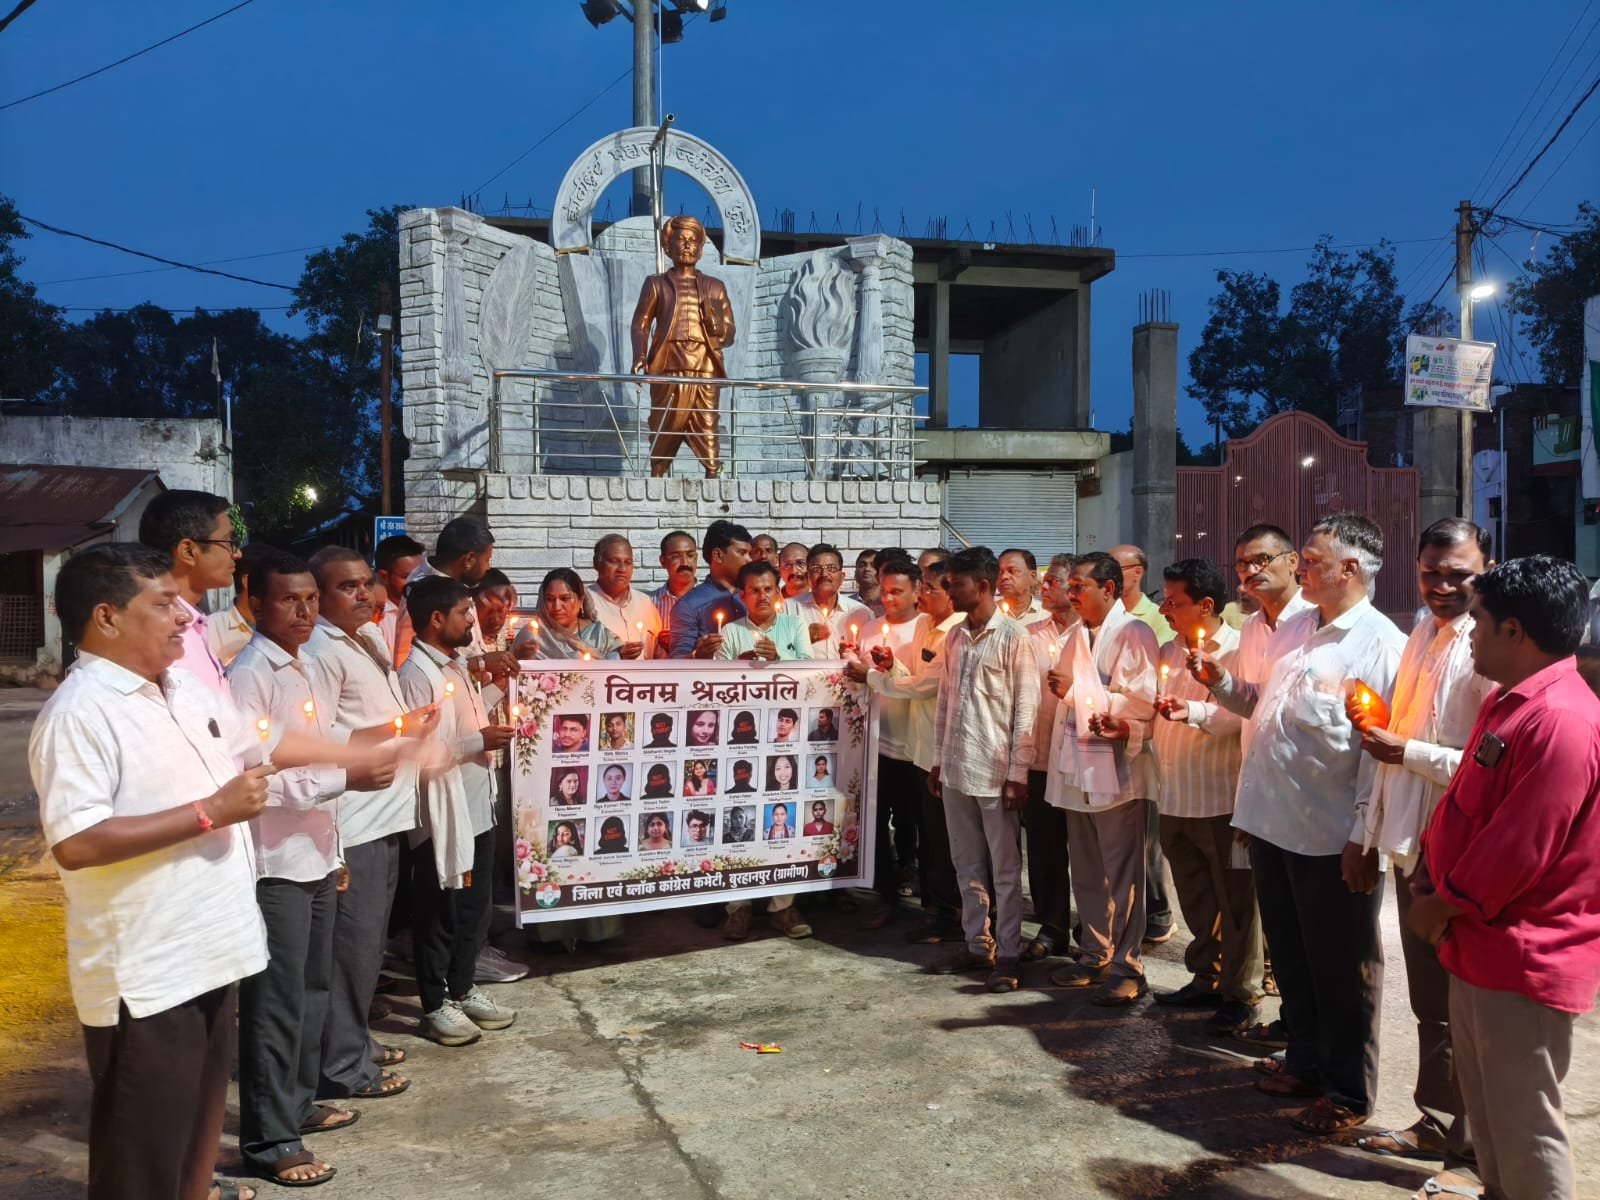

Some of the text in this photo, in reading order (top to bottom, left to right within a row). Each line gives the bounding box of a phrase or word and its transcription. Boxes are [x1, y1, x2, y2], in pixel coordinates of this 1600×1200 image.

[605, 673, 800, 704] विनम्र श्रद्धांजलि
[572, 864, 808, 902] जिला एवं ब्लॉक कांग्रेस कमेटी, बुरहानपुर (ग्रामीण)
